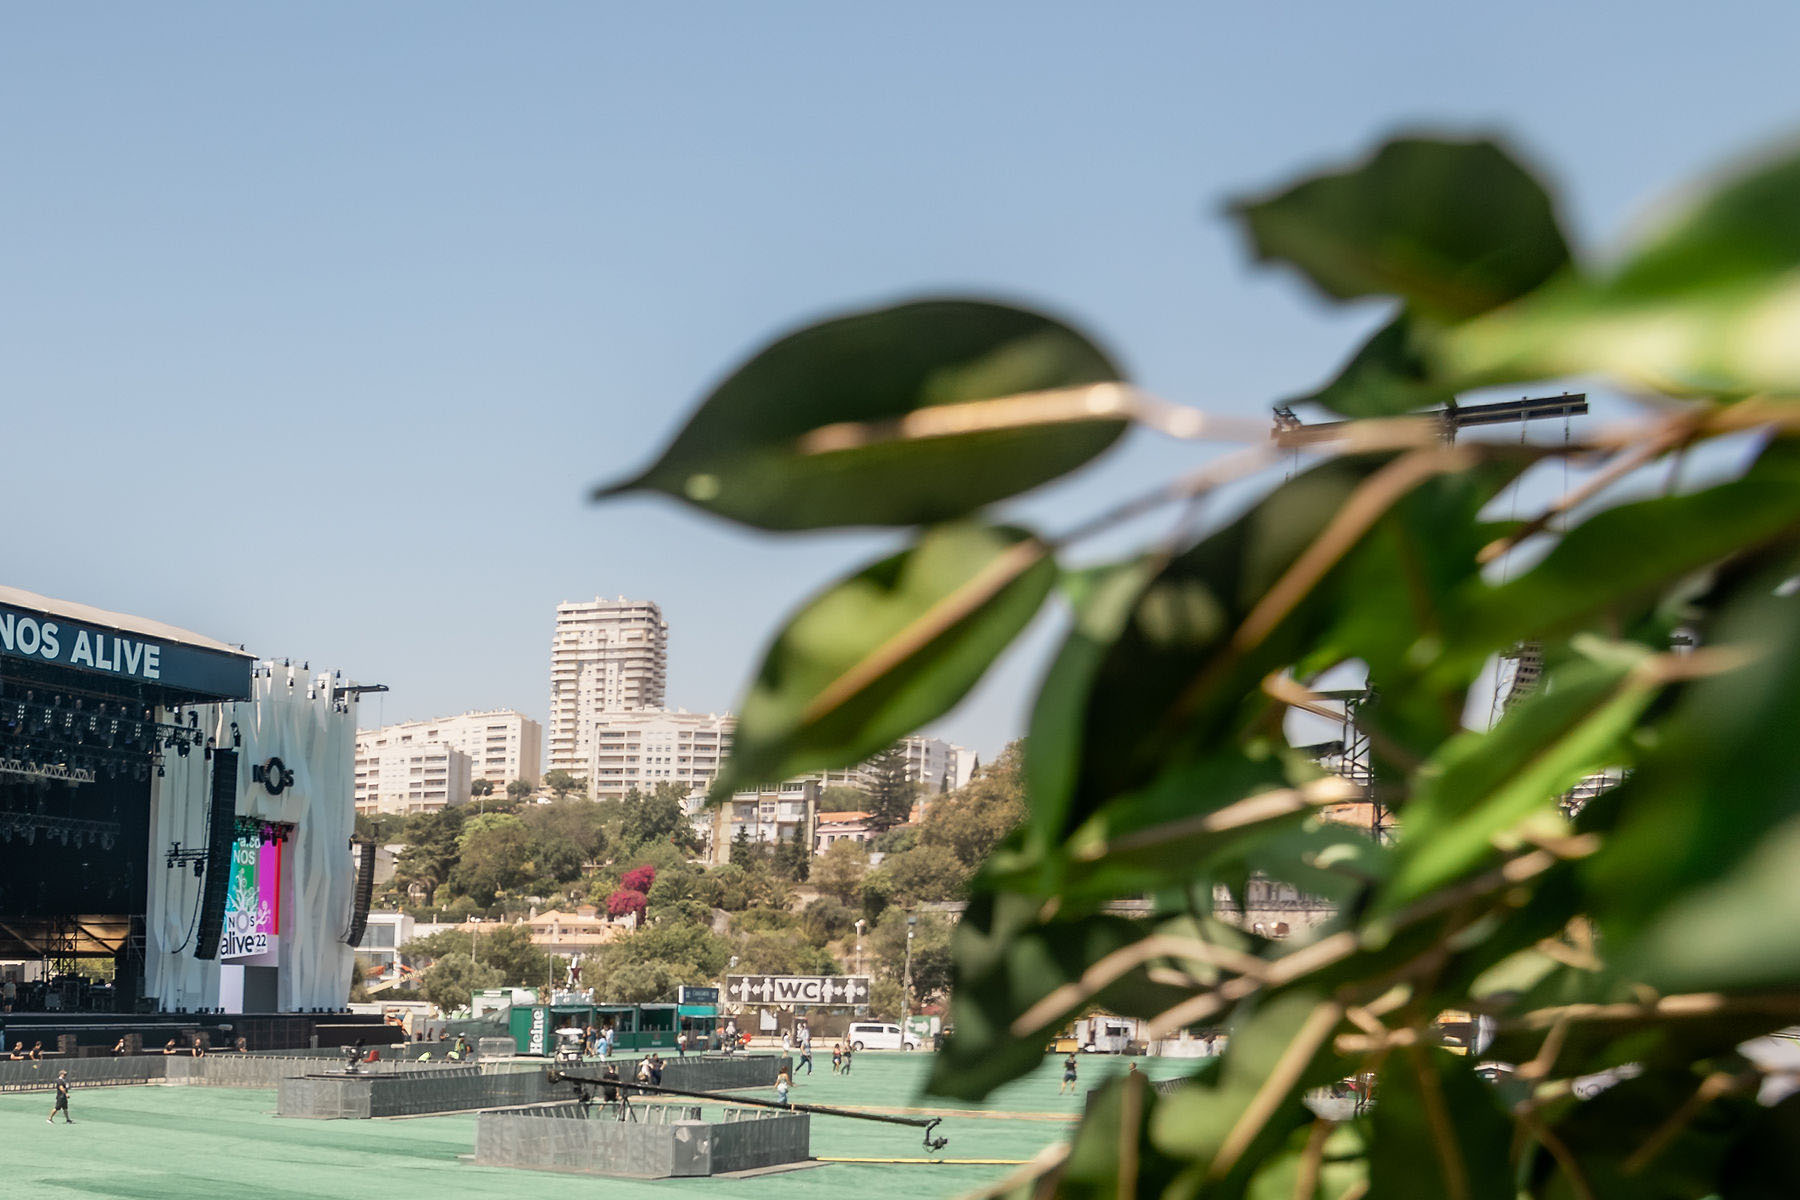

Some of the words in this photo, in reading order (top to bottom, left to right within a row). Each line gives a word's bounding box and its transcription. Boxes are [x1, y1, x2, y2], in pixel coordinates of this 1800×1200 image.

[70, 630, 160, 679] ALIVE
[253, 757, 294, 795] NOS
[233, 850, 255, 865] NOS
[228, 909, 256, 934] NOS
[777, 982, 818, 998] WC
